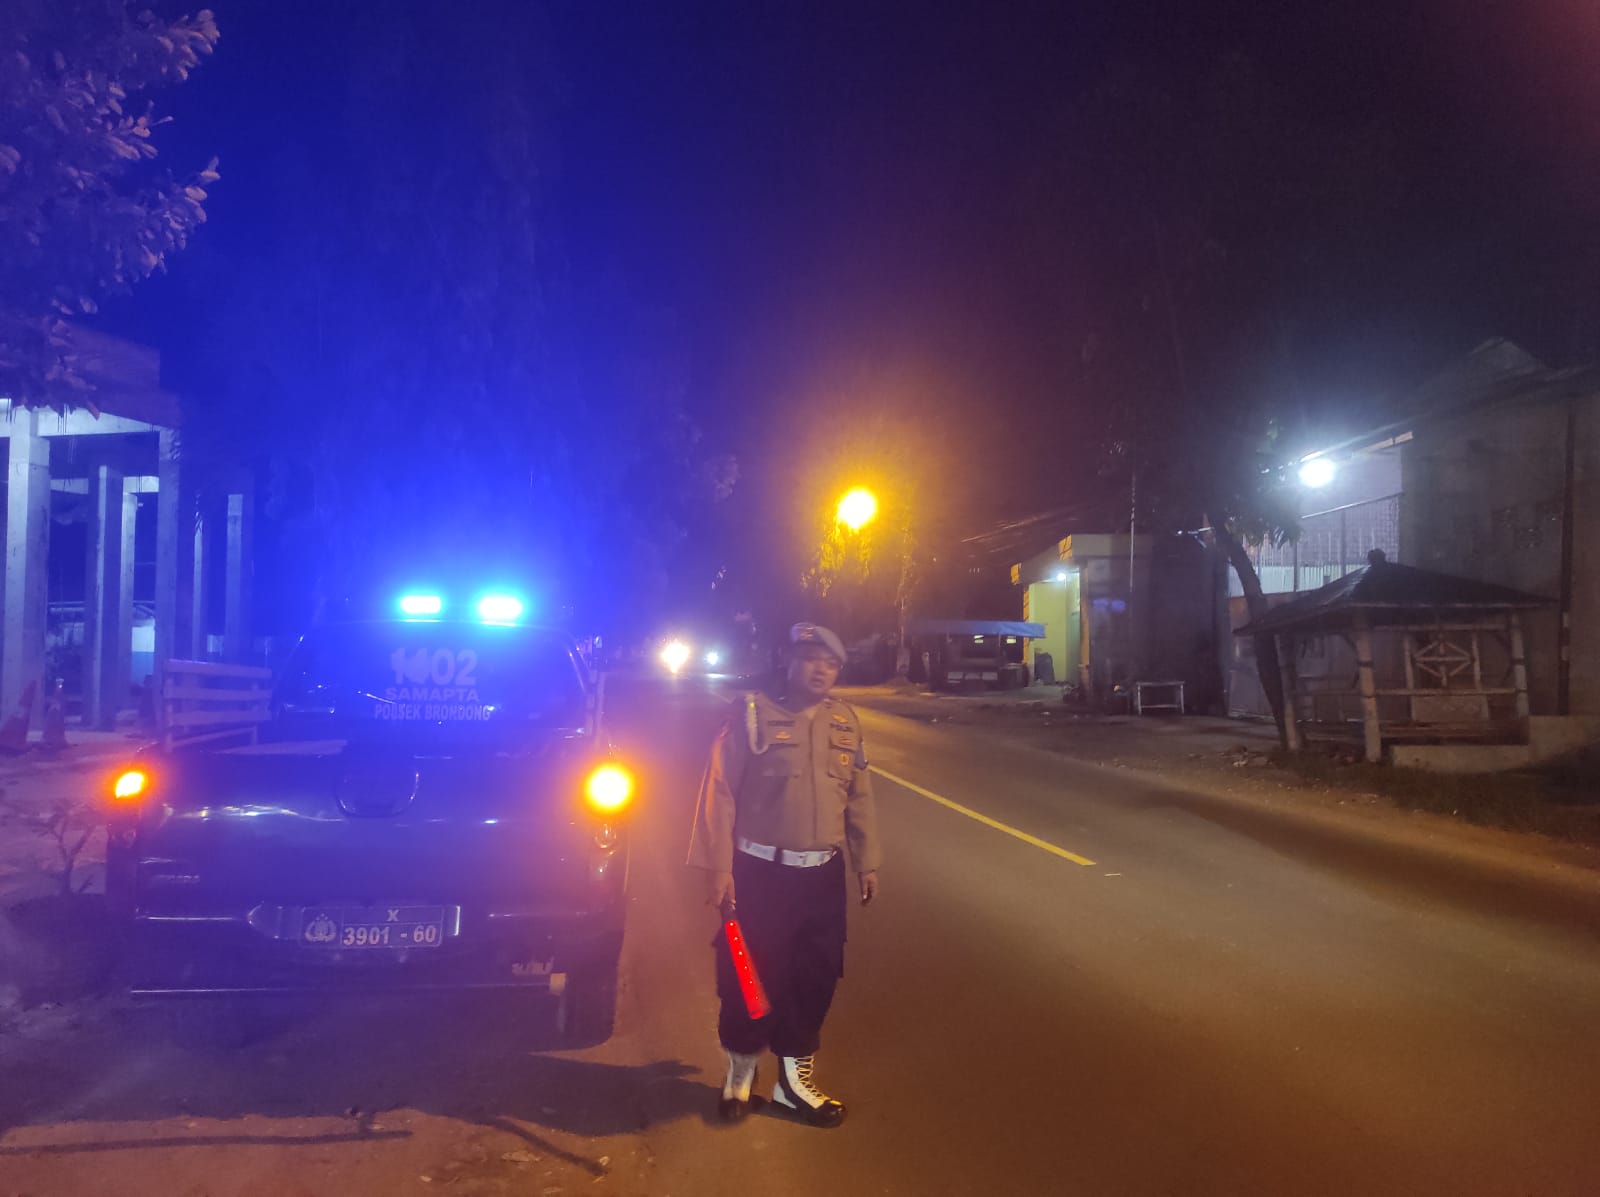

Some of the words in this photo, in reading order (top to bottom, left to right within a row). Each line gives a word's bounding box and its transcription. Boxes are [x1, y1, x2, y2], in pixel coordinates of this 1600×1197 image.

[385, 687, 480, 702] SAMAPTA
[374, 703, 421, 720] POLSEK
[424, 703, 491, 721] BRONDONG
[387, 909, 399, 922] X
[343, 926, 390, 945] 3901
[413, 925, 436, 943] 60
